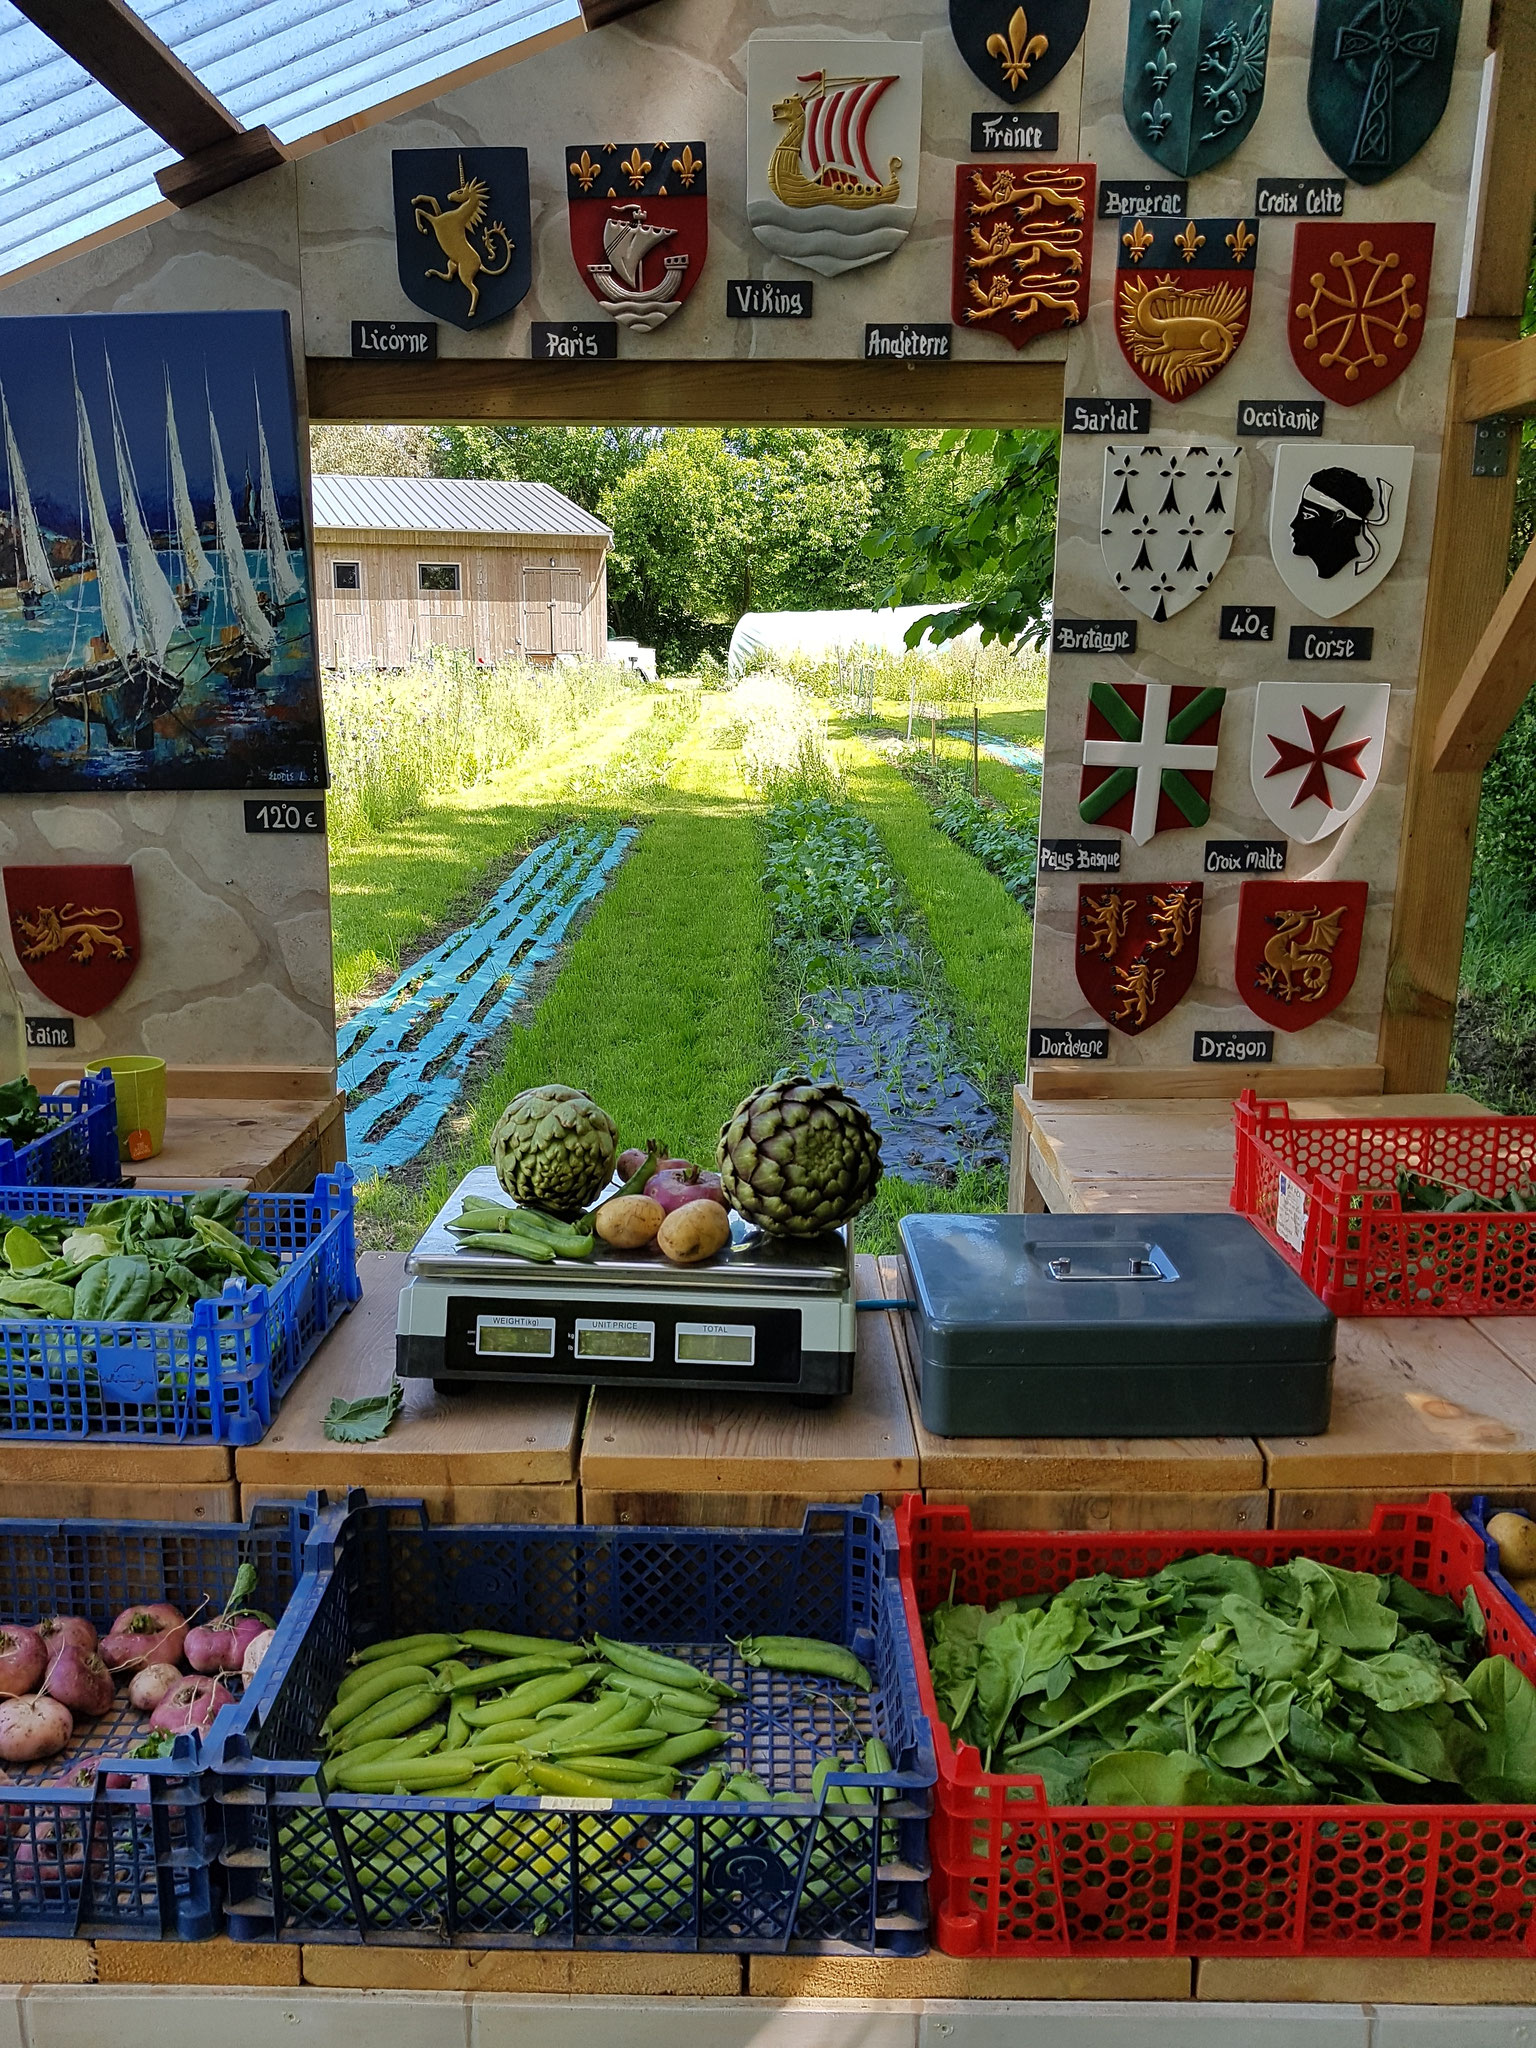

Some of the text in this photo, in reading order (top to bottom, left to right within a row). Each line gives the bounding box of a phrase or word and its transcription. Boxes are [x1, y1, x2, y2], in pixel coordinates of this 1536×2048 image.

[981, 115, 1042, 148] France
[1104, 190, 1181, 217] Bergerac
[1259, 187, 1342, 214] Croix Celte
[361, 325, 429, 353] Licorne
[545, 332, 598, 357] Paris
[867, 329, 948, 358] Angleterre
[1072, 402, 1139, 431] Sarlat
[1243, 406, 1320, 431] Occitanie
[1057, 627, 1130, 653] Bretagne
[1304, 634, 1354, 659] Corse
[1040, 846, 1120, 871] Pays Basque
[1207, 846, 1283, 871] Croix Malte
[1038, 1031, 1103, 1058] Dordogne
[1200, 1036, 1267, 1060] Dragon
[493, 1316, 540, 1327] WEIGHT(kg)
[592, 1321, 638, 1330] UNIT PRICE
[702, 1325, 728, 1333] TOTAL
